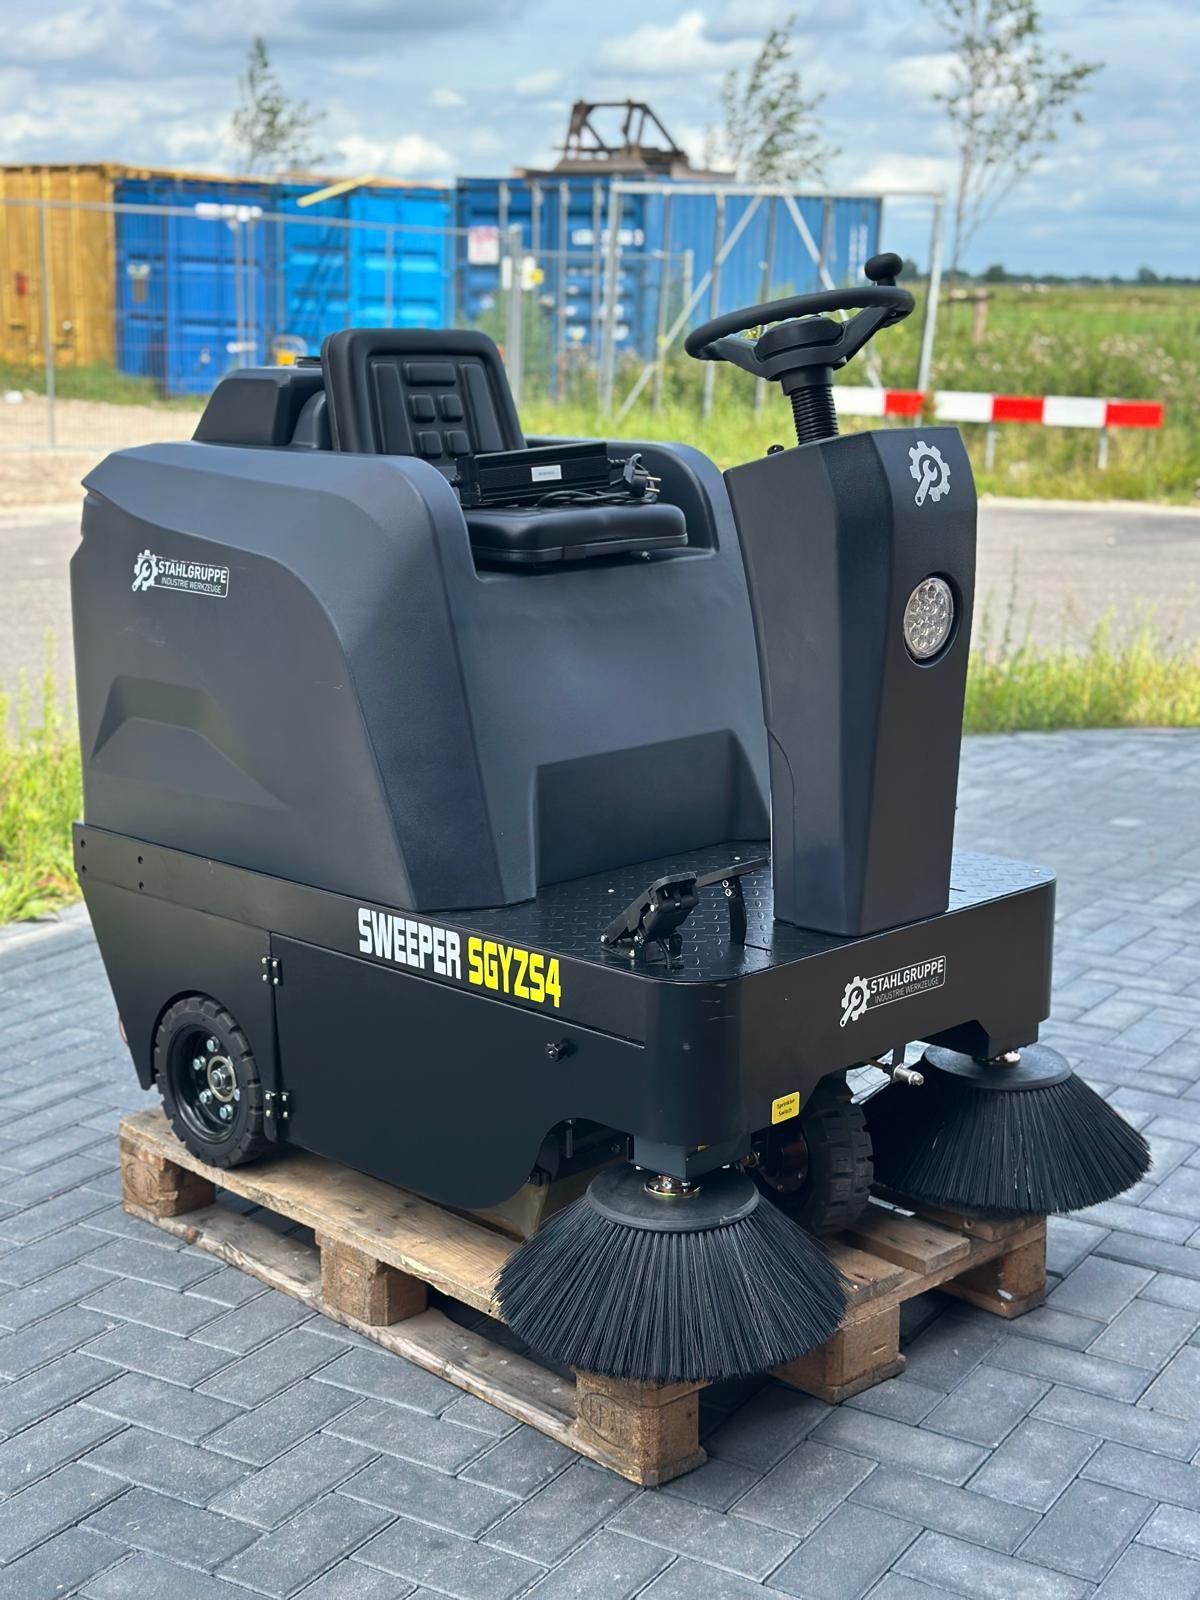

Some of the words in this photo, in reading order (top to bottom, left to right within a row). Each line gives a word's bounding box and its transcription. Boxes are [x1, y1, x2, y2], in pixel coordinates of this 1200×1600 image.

[158, 560, 227, 584] STAHLGRUPPE
[161, 576, 189, 589] INDUSTRIE
[189, 580, 222, 594] WERKZEUGE
[358, 907, 462, 980] SWEEPER
[468, 936, 562, 1009] SGYZS4
[870, 959, 944, 994] STAHLGRUPPE
[875, 987, 905, 1004] INDUSTRIE
[905, 976, 940, 996] WERKZEUGE
